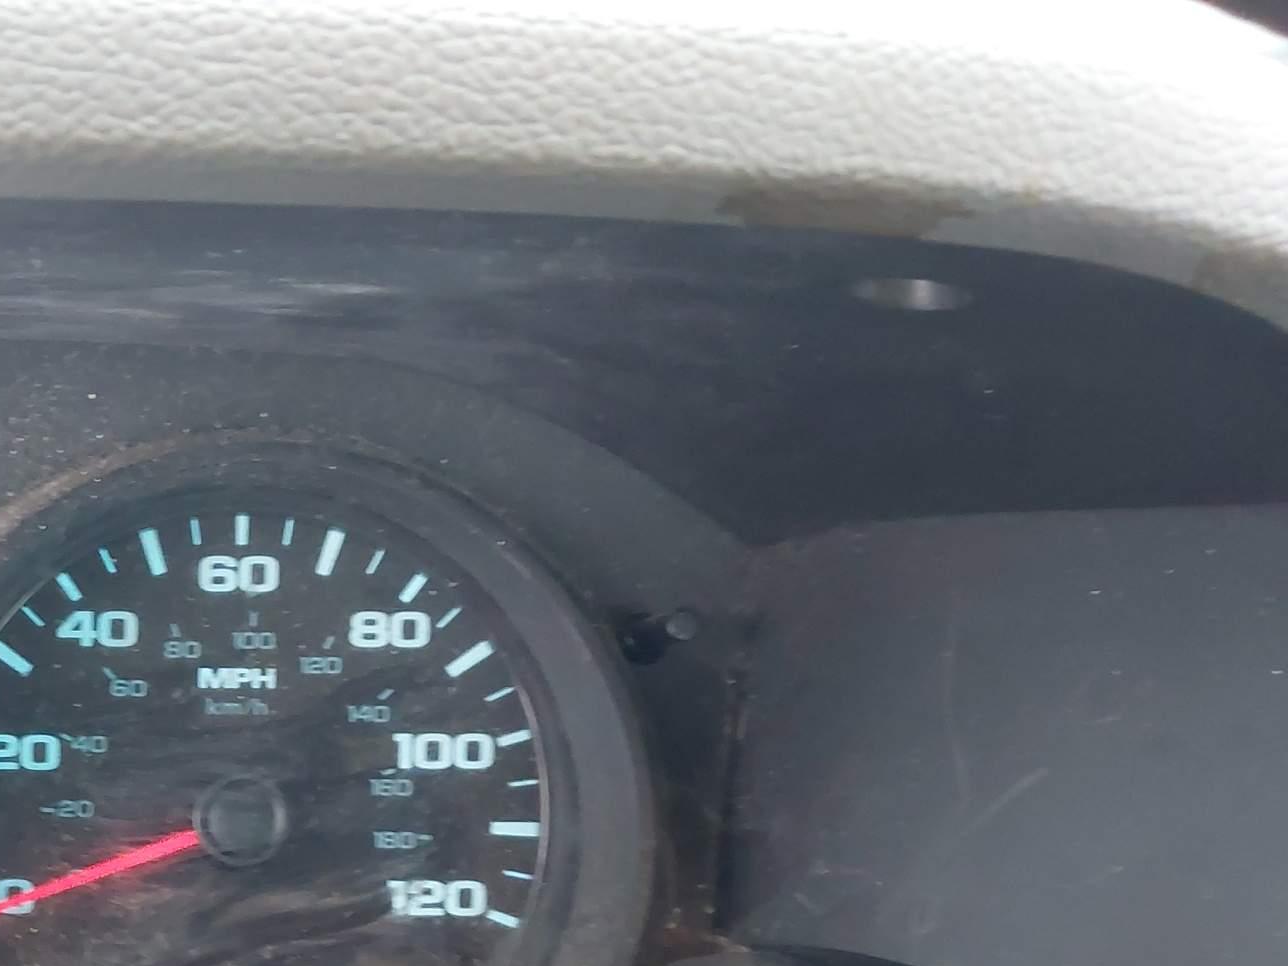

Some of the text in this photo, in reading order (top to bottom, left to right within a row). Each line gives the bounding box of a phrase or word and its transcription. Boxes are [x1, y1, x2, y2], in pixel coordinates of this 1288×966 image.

[198, 555, 280, 592] 60
[56, 611, 140, 648] 40
[348, 611, 431, 648] 80
[164, 641, 202, 659] 80
[232, 632, 277, 650] 100
[299, 656, 343, 674] 120
[109, 679, 148, 697] 60
[197, 667, 277, 689] MPH
[70, 735, 109, 754] 40
[392, 733, 495, 769] 100
[55, 800, 95, 818] 20
[386, 880, 488, 917] 120
